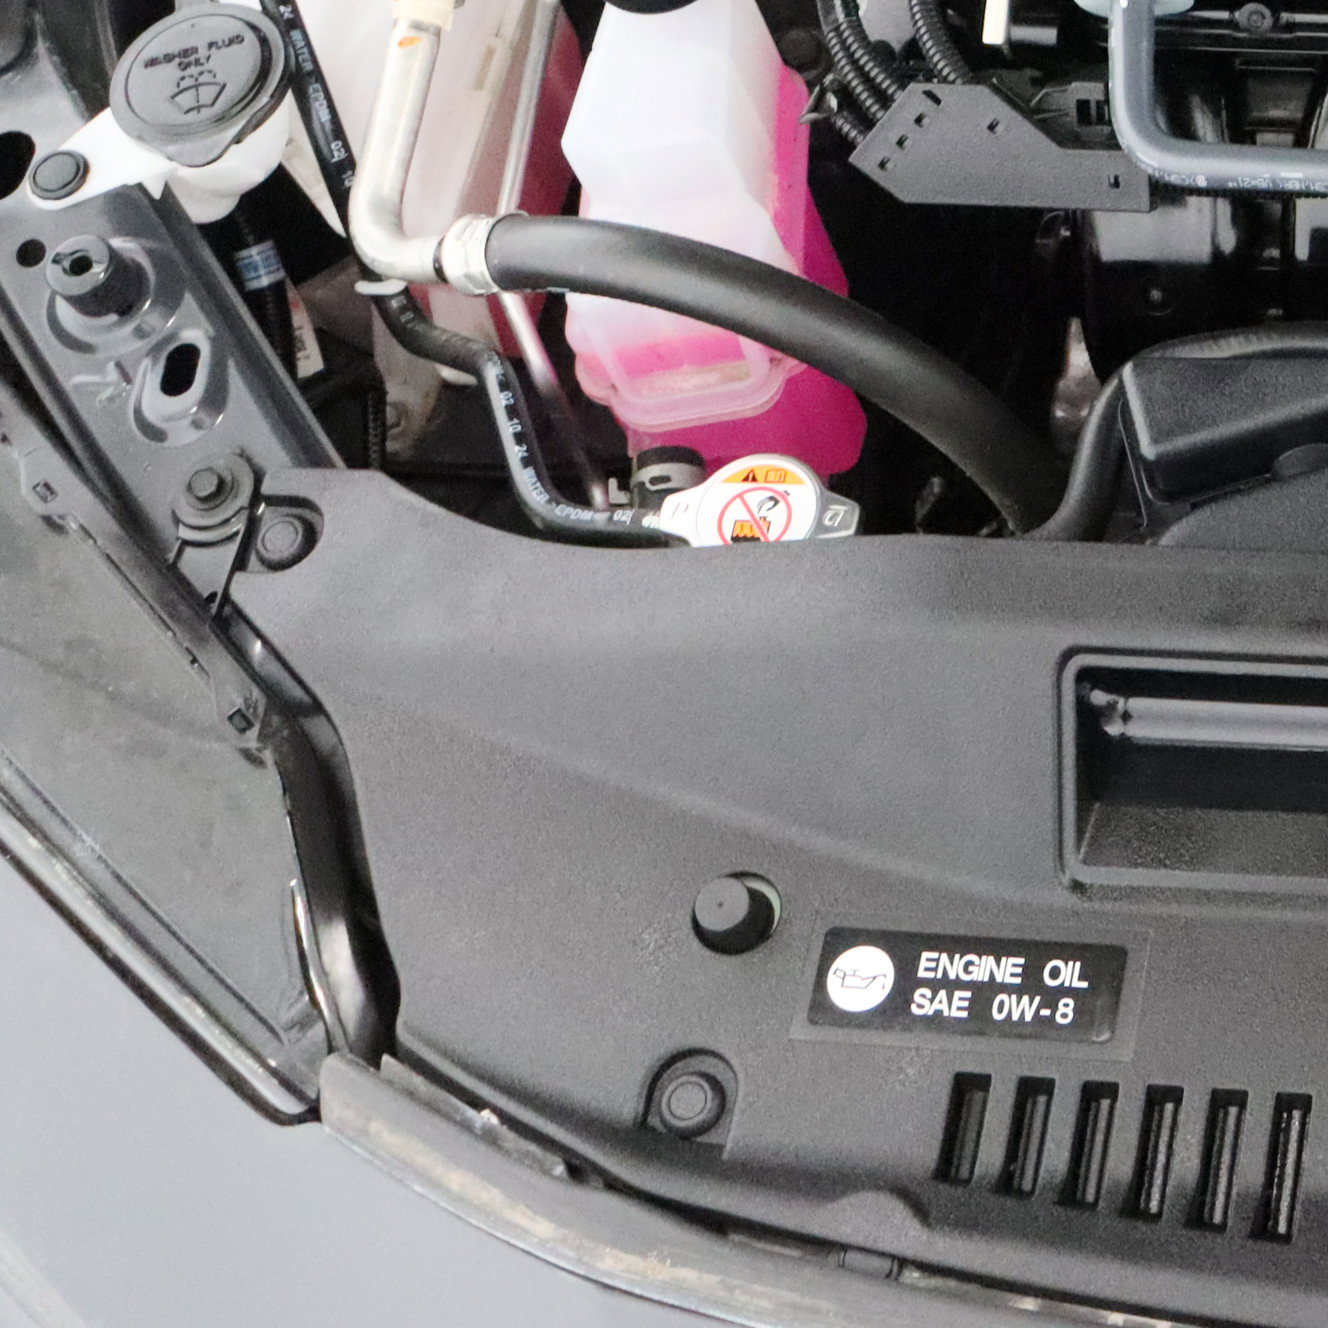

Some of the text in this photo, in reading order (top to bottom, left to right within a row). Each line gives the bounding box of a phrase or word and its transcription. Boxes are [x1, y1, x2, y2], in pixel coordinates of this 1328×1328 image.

[143, 33, 245, 69] WASHER FLUID
[177, 54, 211, 71] ONLY
[290, 29, 314, 71] WATER
[509, 418, 522, 433] 10
[522, 466, 550, 504] WATER
[916, 951, 1089, 988] ENGINE OIL
[910, 987, 1075, 1024] SAE 0W-8
